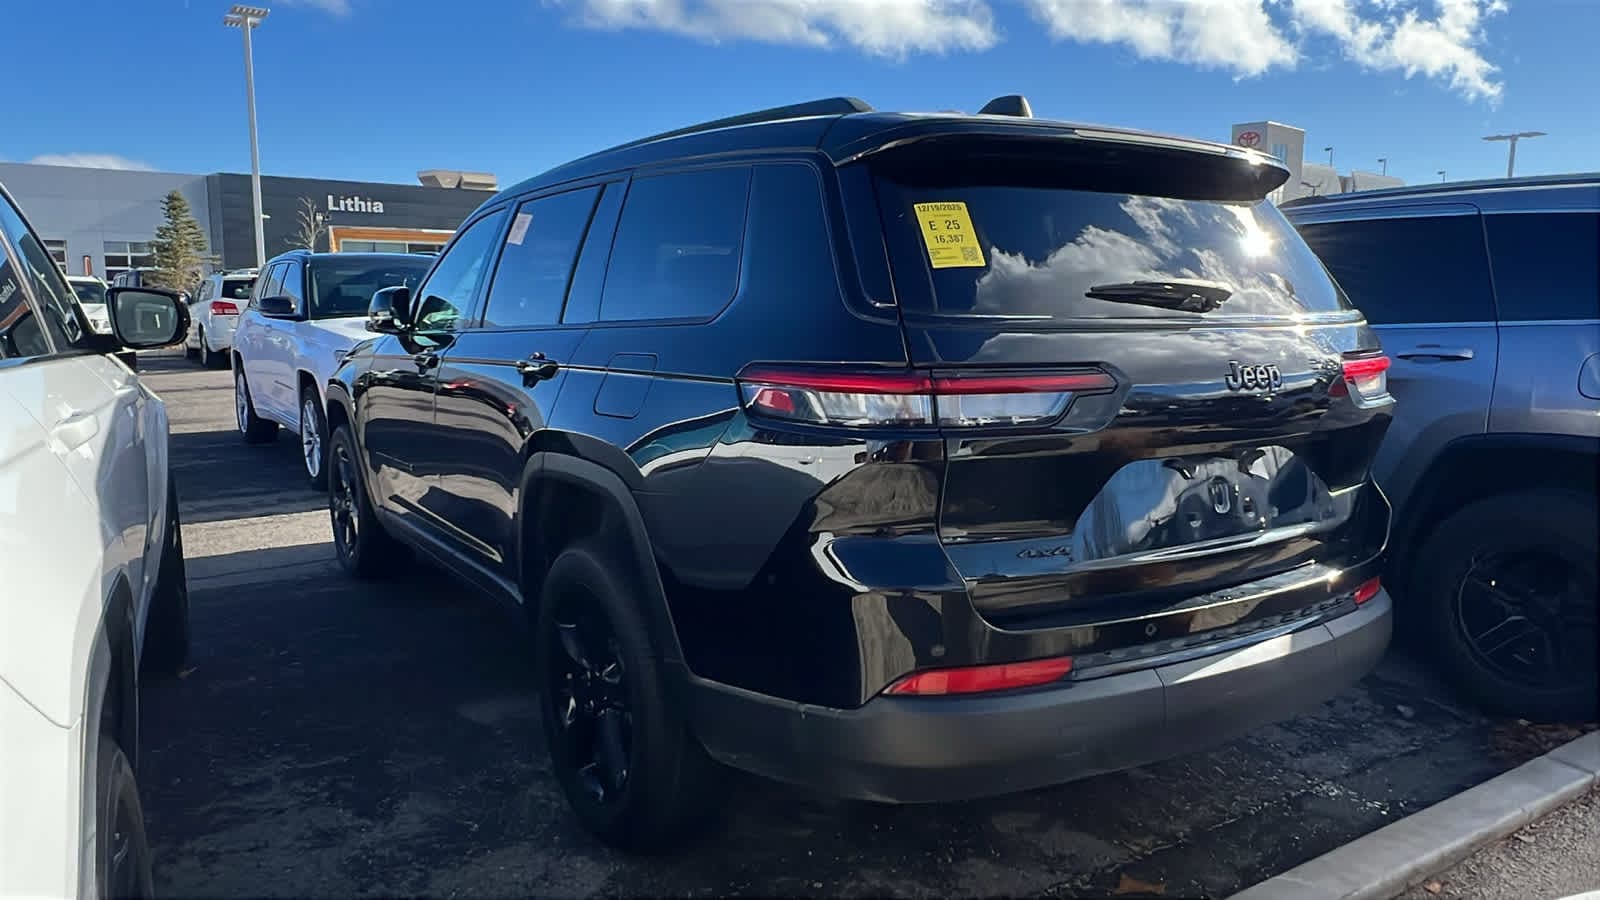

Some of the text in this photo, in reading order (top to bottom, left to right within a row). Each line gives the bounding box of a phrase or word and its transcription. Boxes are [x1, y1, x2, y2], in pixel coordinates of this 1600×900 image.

[327, 194, 384, 213] Lithia
[928, 219, 961, 231] E 25
[1225, 359, 1282, 393] Jeep
